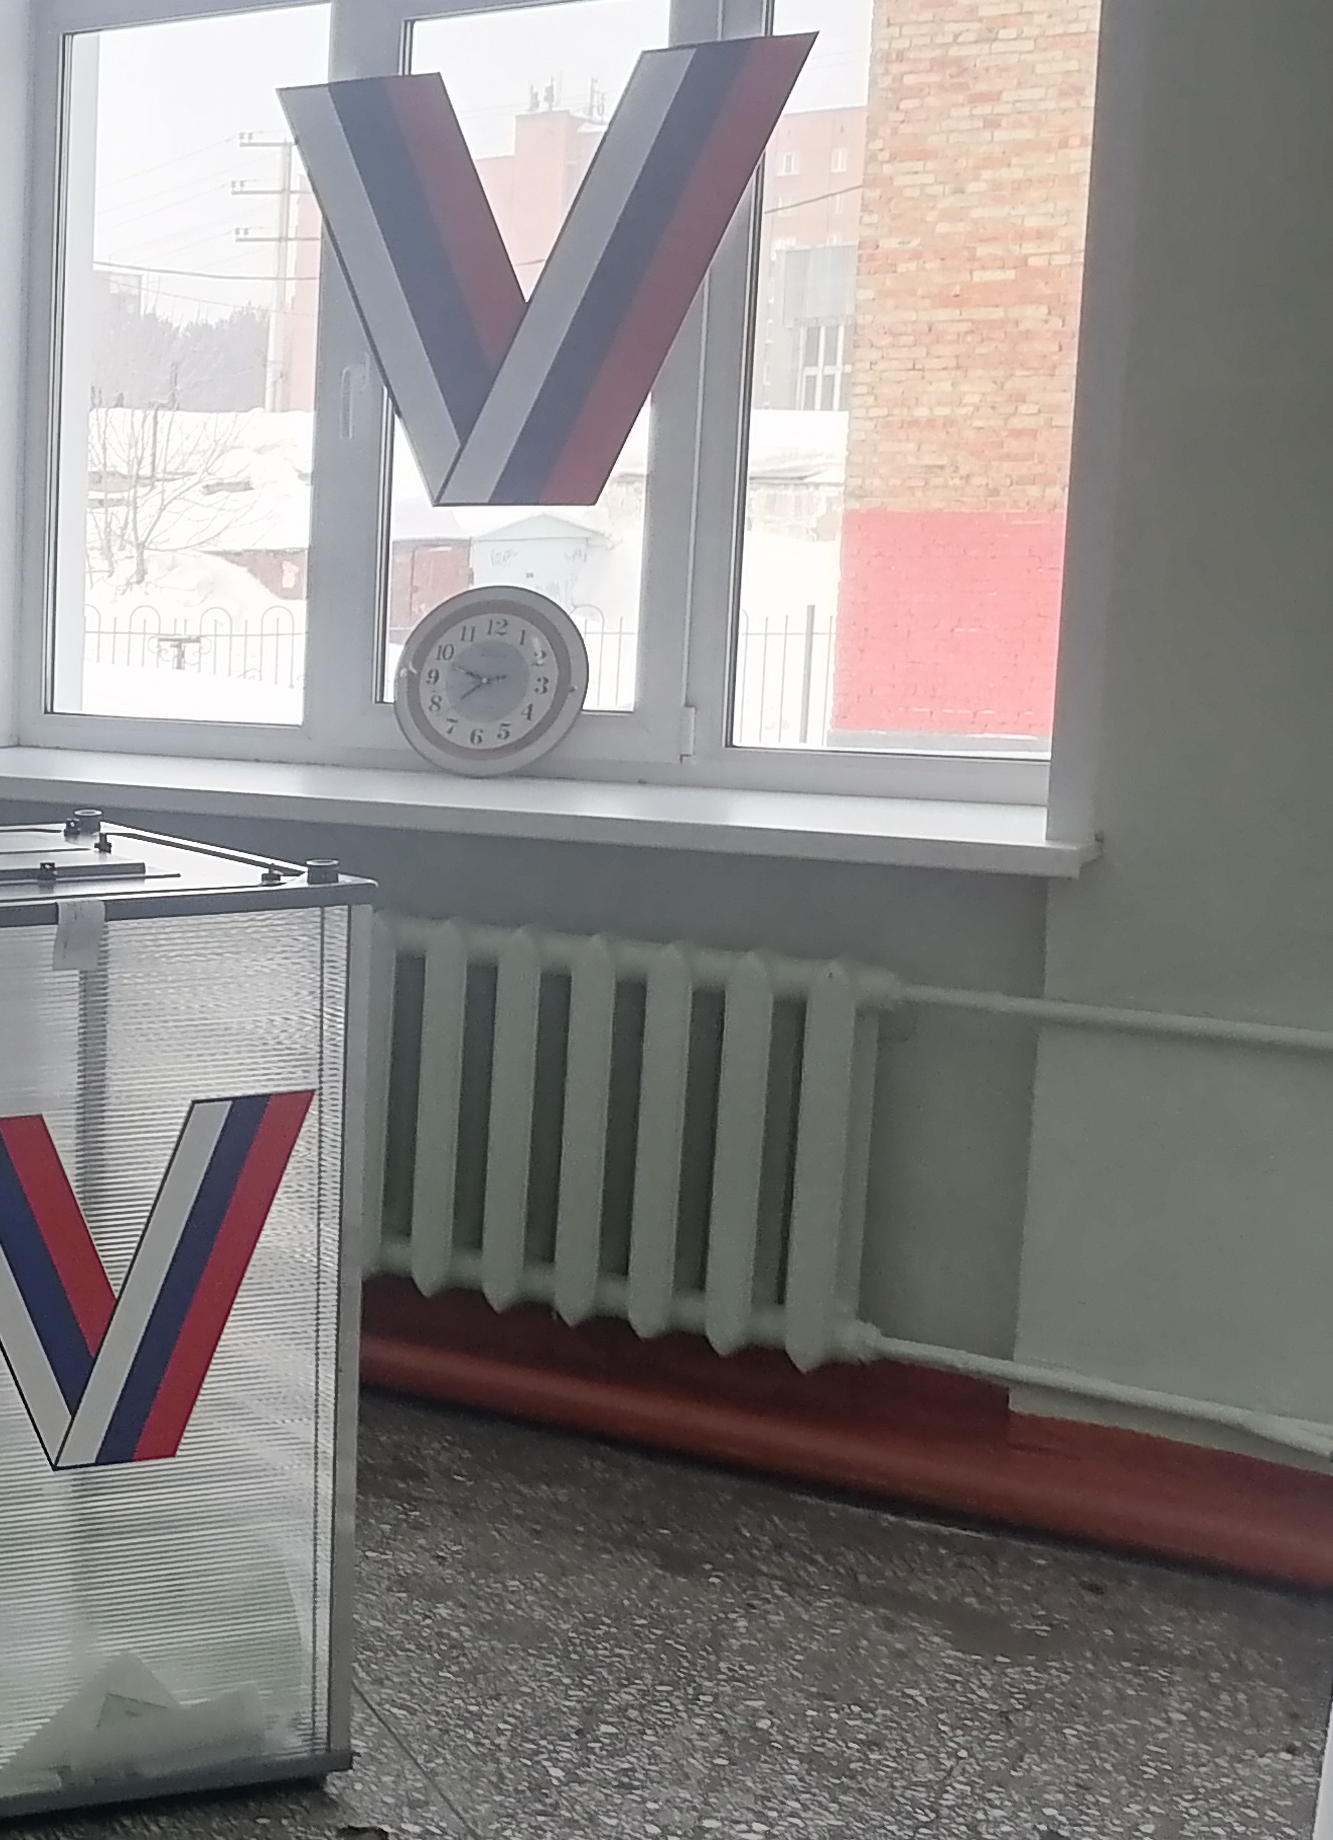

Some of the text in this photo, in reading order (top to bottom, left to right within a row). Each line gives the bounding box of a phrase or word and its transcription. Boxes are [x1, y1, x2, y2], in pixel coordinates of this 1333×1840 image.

[277, 31, 819, 506] V
[460, 625, 476, 642] 11
[487, 619, 508, 636] 12
[519, 629, 526, 646] 1
[436, 643, 454, 660] 10
[533, 650, 547, 667] 2
[426, 669, 440, 685] 9
[534, 676, 549, 694] 3
[428, 695, 442, 712] 8
[521, 703, 533, 721] 4
[446, 718, 458, 734] 7
[497, 723, 512, 740] 5
[470, 728, 483, 745] 6
